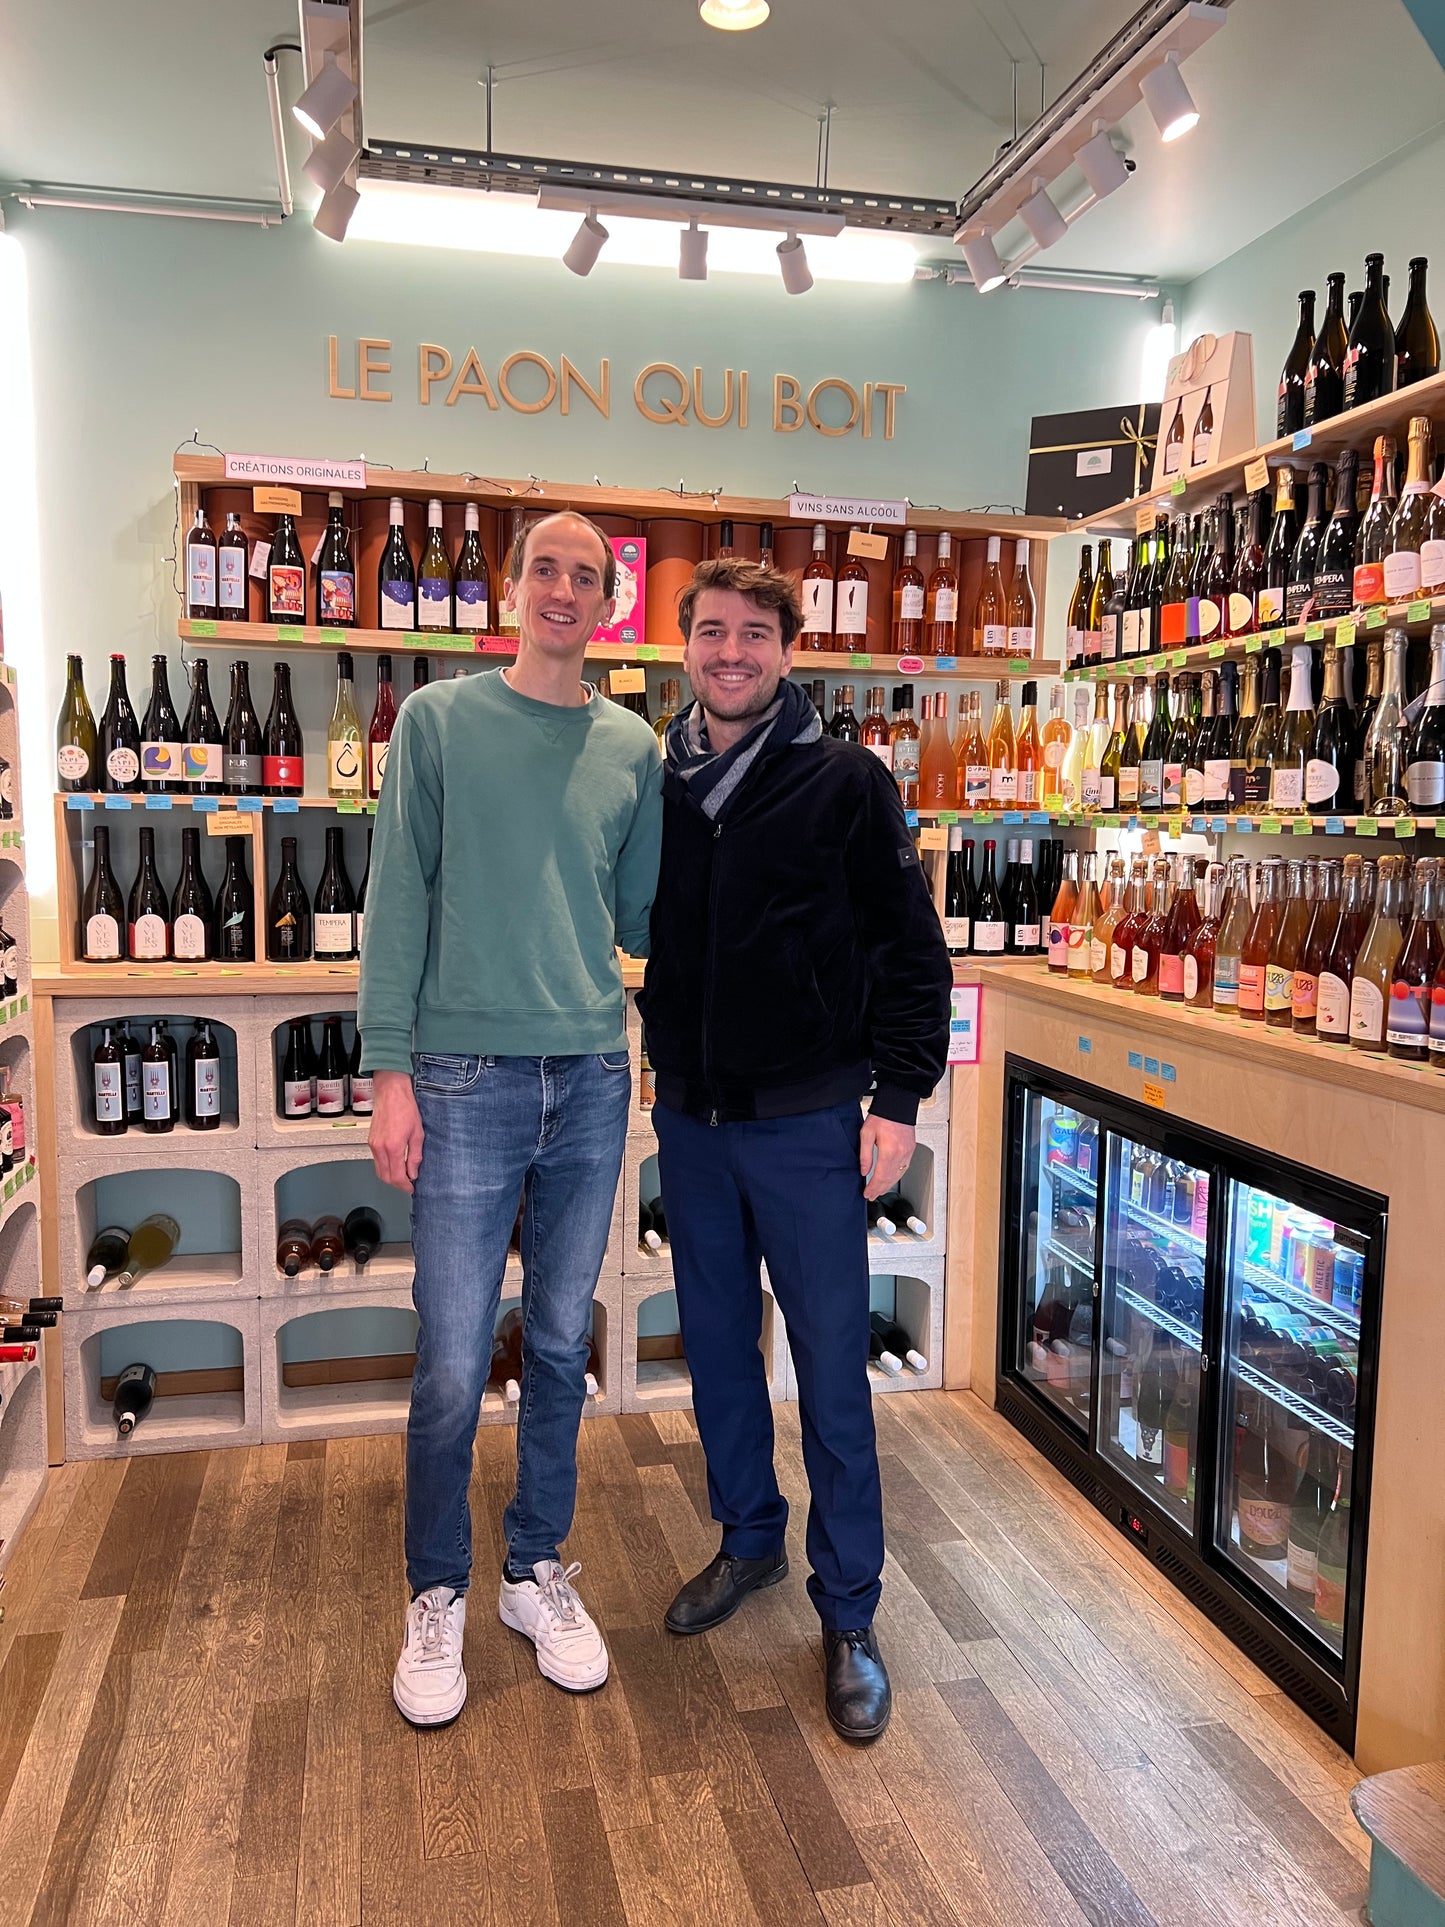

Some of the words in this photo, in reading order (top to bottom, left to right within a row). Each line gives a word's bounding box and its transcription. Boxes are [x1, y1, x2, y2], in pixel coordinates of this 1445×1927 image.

[328, 334, 393, 402] LE
[418, 342, 611, 420] PAON
[633, 360, 749, 430] QUI
[772, 372, 908, 440] BOIT
[229, 461, 295, 477] CRÉATIONS
[297, 465, 362, 481] ORIGINALES
[797, 502, 823, 513] VINS
[825, 504, 855, 516] SANS
[857, 505, 899, 518] ALCOOL
[1313, 573, 1344, 585] TEMPERA
[229, 758, 248, 767] MUR
[1314, 1260, 1325, 1294] ATHLETIC
